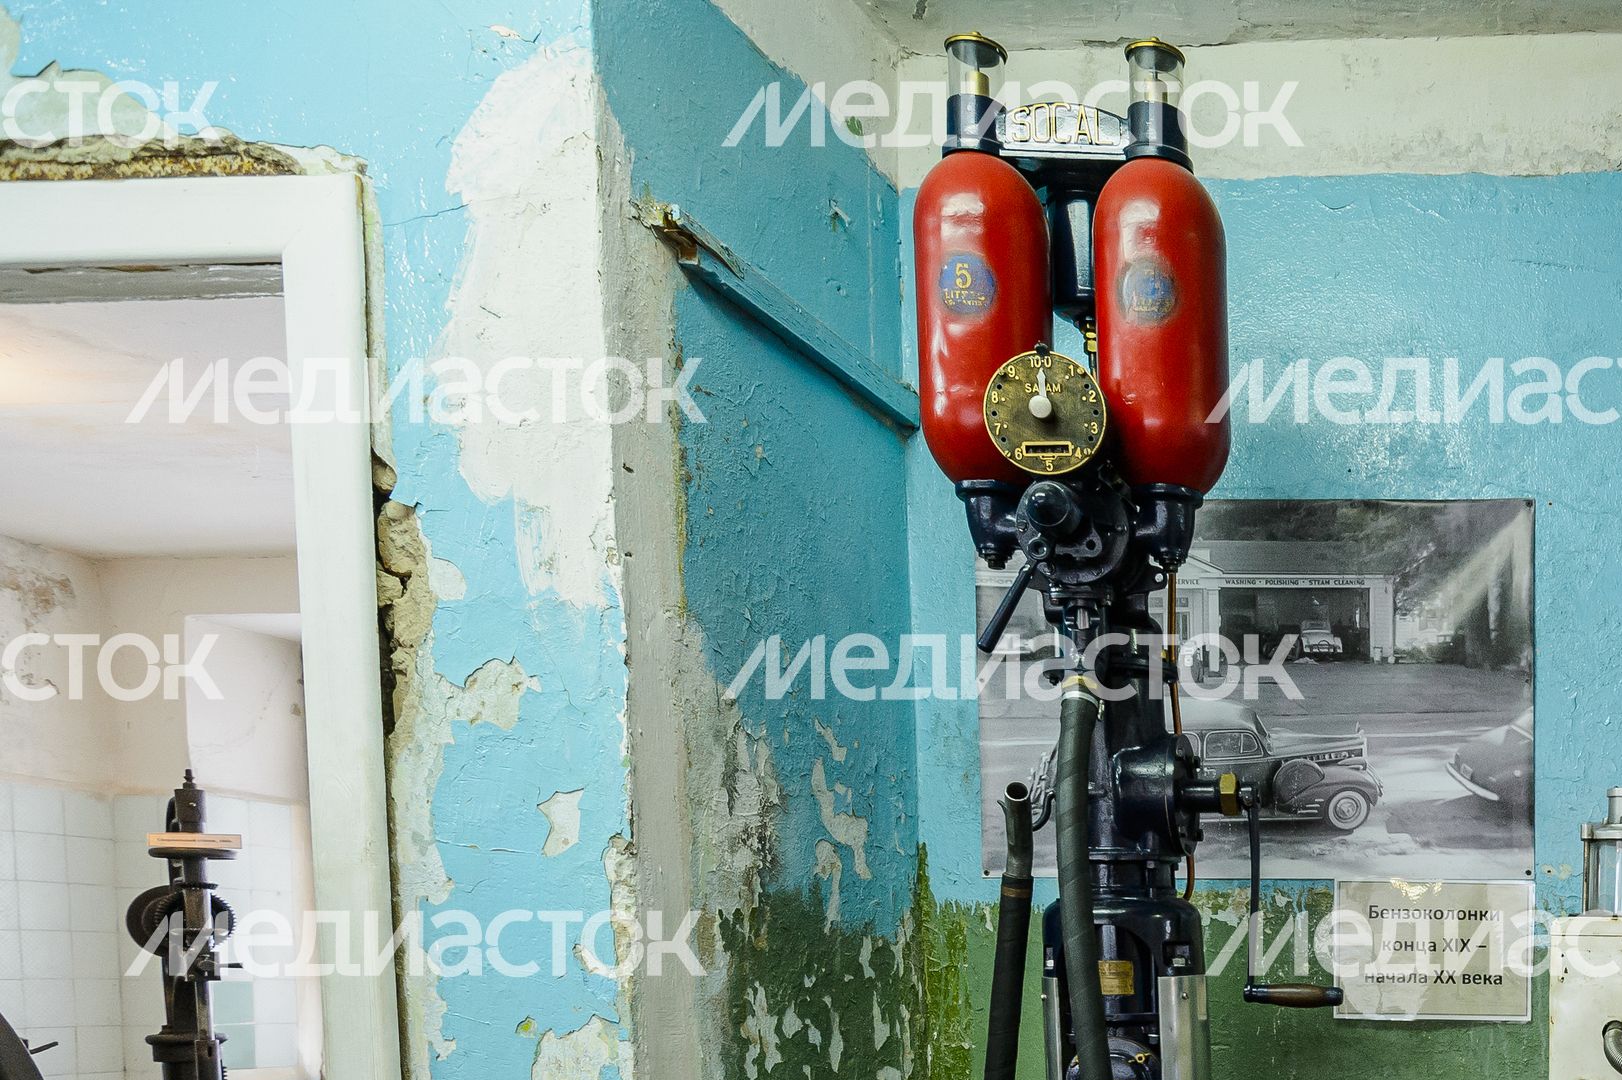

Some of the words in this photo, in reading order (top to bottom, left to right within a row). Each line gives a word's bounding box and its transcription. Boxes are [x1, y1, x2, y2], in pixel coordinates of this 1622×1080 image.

[1010, 103, 1114, 144] SOCAL
[955, 262, 972, 289] 5
[1007, 365, 1016, 378] 9
[1068, 364, 1075, 376] 1
[1024, 383, 1061, 393] SAAM
[991, 391, 999, 404] 8
[1088, 390, 1097, 402] 2
[994, 422, 1001, 435] 7
[1090, 421, 1098, 434] 3
[1014, 447, 1023, 460] 6
[1074, 446, 1081, 459] 4
[1045, 460, 1054, 471] 5
[1368, 905, 1501, 921] Бензоколонки
[1382, 940, 1437, 955] конца
[1442, 938, 1471, 953] XIX
[1365, 972, 1428, 985] начала
[1433, 970, 1457, 985] XX
[1462, 973, 1503, 986] века
